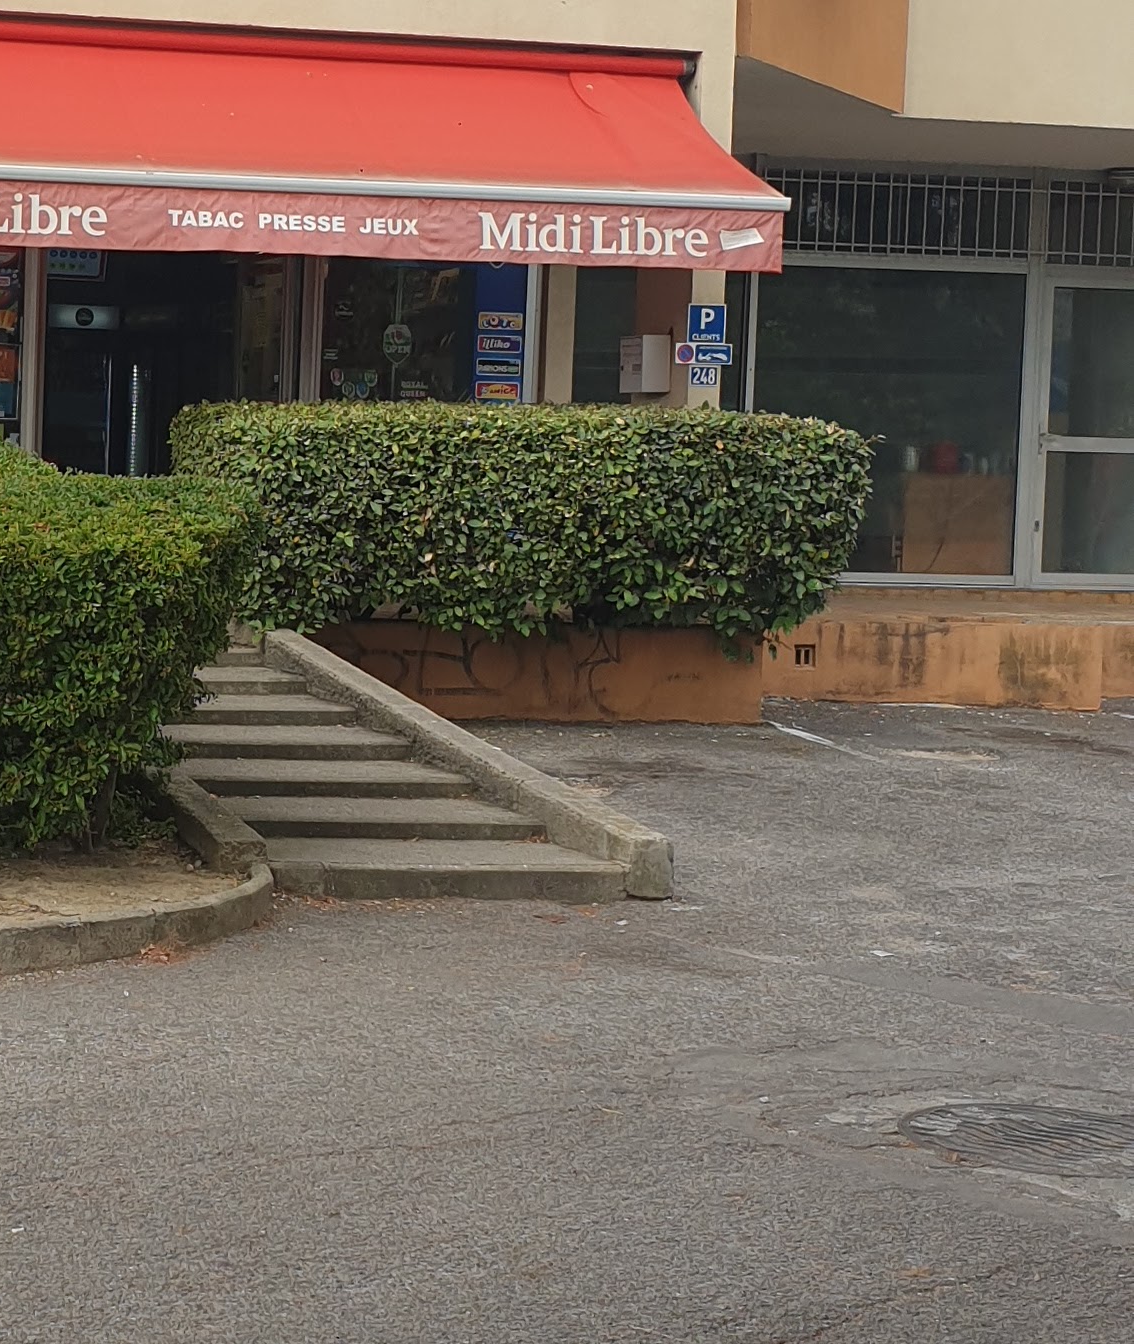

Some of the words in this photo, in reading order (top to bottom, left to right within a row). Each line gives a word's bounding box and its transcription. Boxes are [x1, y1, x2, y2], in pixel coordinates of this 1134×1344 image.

[168, 209, 244, 229] TABAC
[258, 213, 346, 233] PRESSE
[359, 217, 420, 236] JEUX
[478, 212, 584, 254] Midi
[589, 215, 709, 257] Libre
[692, 333, 721, 342] CLIENTS
[692, 367, 716, 385] 248
